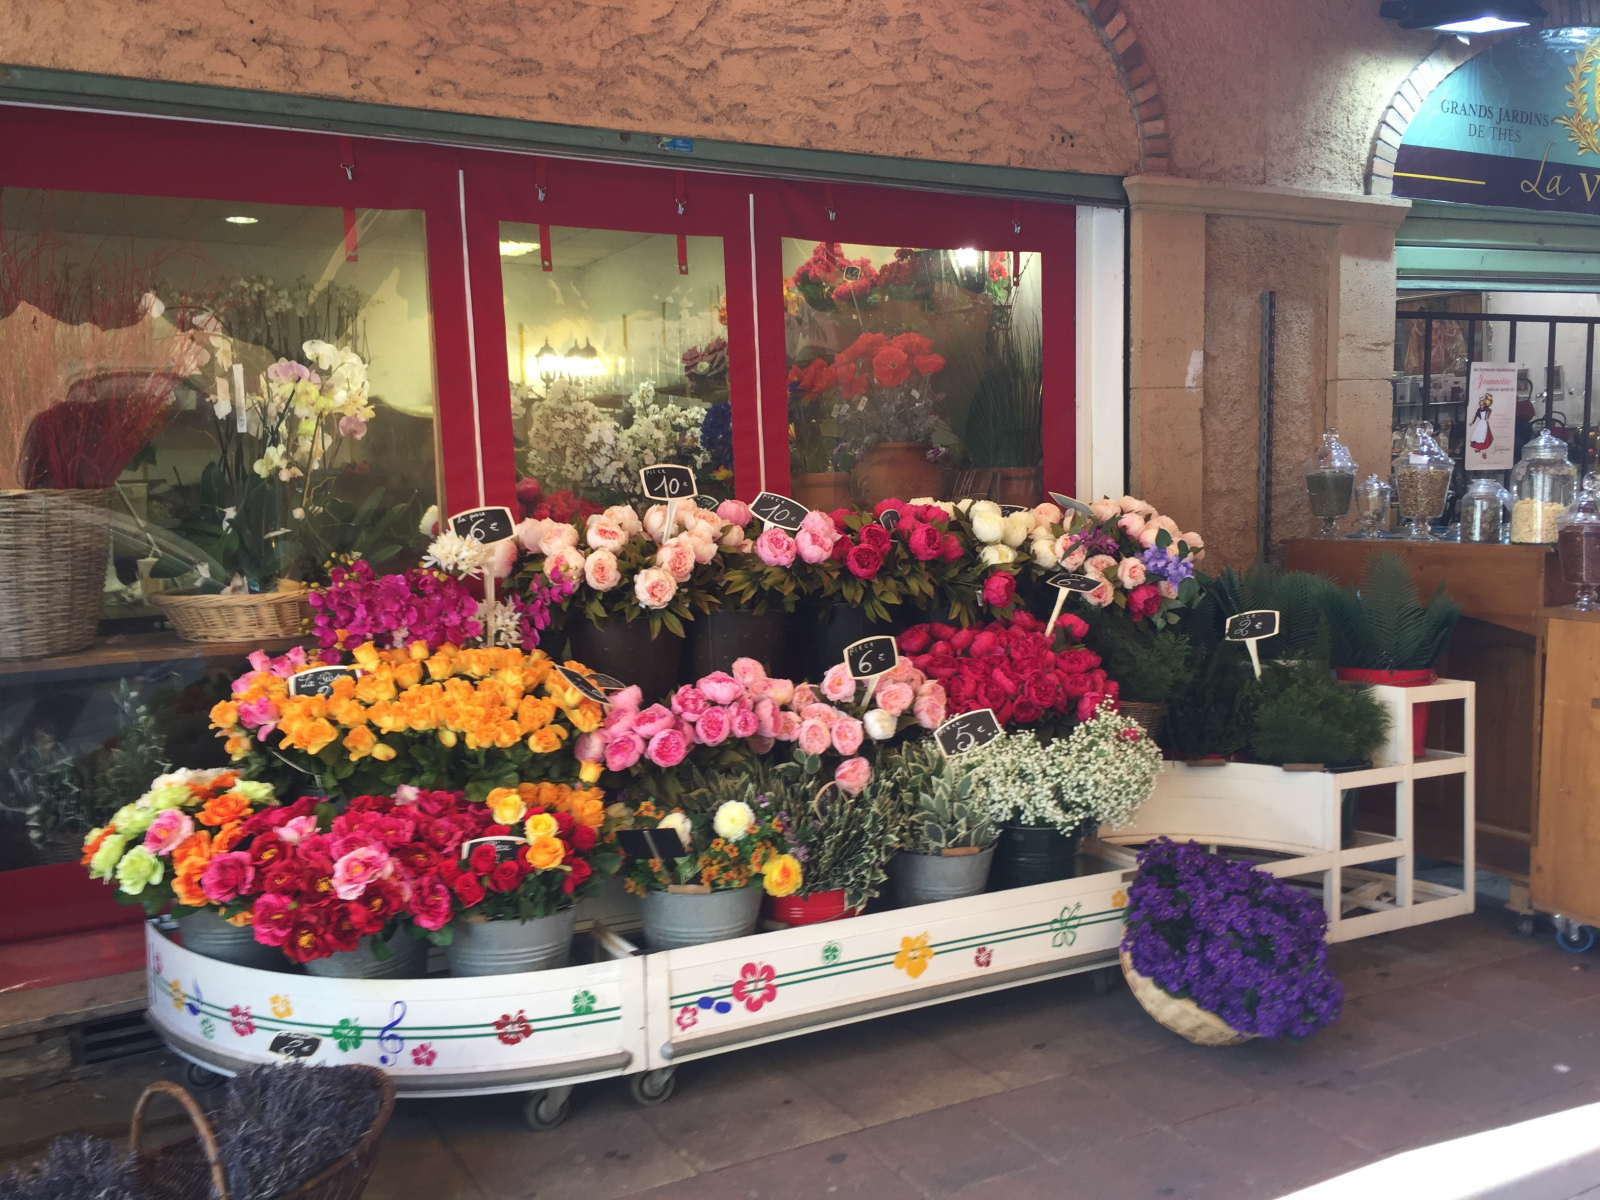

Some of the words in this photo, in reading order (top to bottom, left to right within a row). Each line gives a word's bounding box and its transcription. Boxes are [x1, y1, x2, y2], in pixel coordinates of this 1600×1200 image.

[1440, 99, 1494, 120] GRANDS
[1496, 107, 1550, 127] JARDINS
[1468, 123, 1485, 139] DE
[1489, 125, 1522, 143] THÉS
[1520, 139, 1571, 201] La
[1476, 373, 1511, 390] Jeannette
[653, 475, 680, 499] 10
[759, 503, 790, 522] 10
[470, 518, 486, 541] 6
[489, 521, 500, 532] €
[1233, 619, 1252, 637] 2
[1254, 621, 1263, 630] €
[858, 649, 873, 674] 6
[877, 652, 886, 662] €
[955, 722, 976, 752] 5
